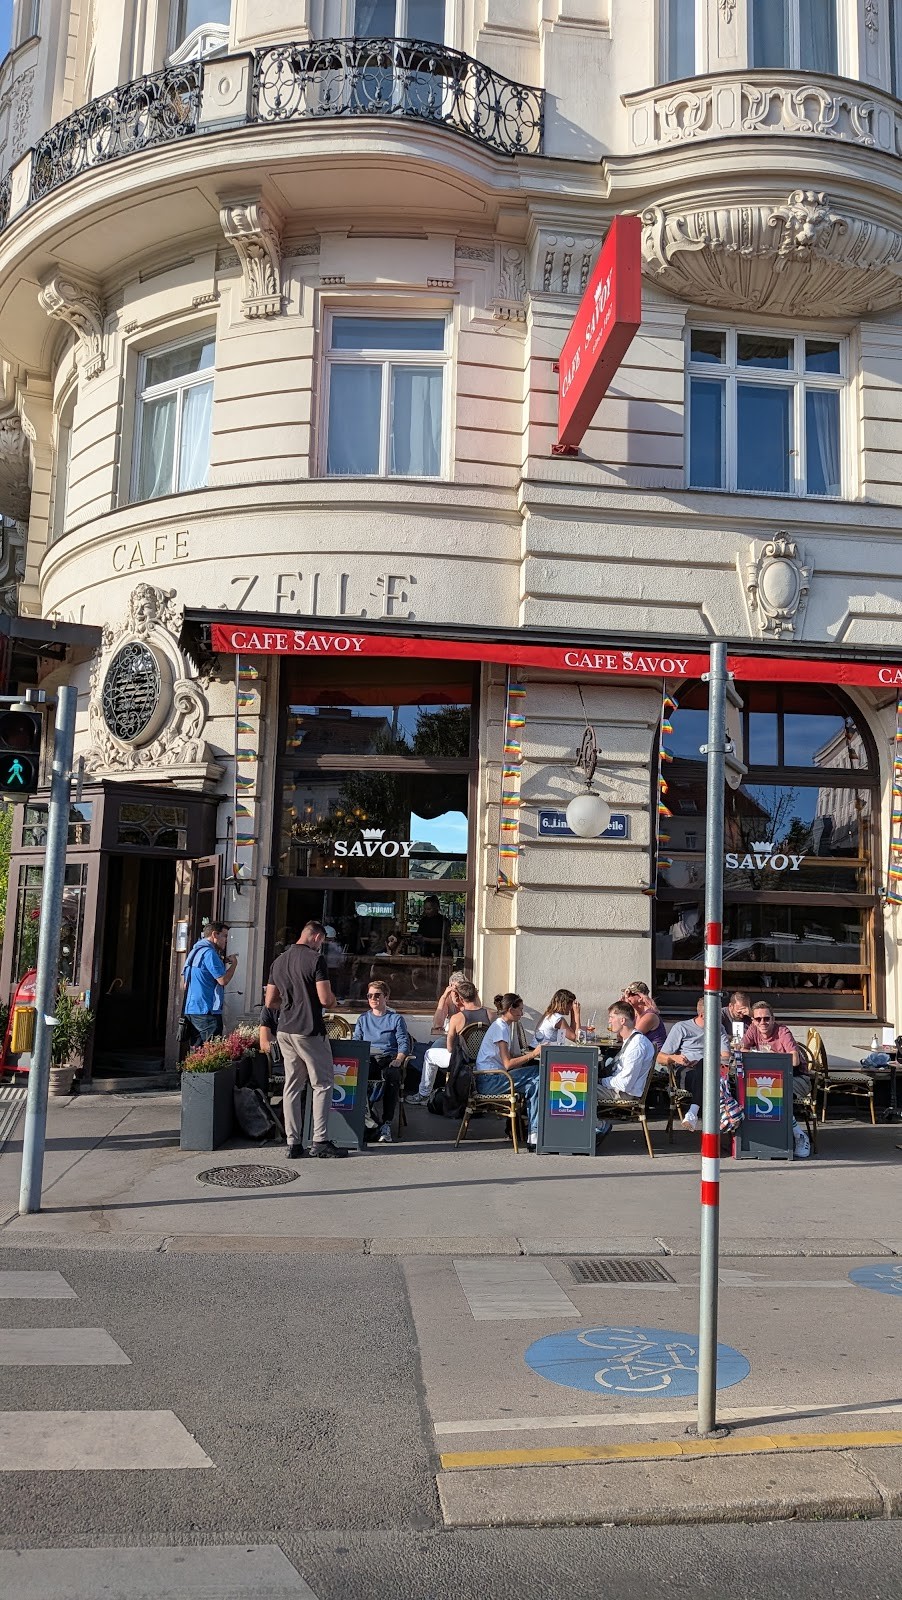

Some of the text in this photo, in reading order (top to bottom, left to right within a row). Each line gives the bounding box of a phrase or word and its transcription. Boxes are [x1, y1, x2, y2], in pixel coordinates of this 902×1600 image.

[562, 267, 613, 398] CAFE SAVOY
[112, 530, 189, 572] CAFE
[230, 572, 417, 619] ZEILE
[231, 631, 366, 652] CAFE SAVOY
[564, 652, 690, 674] CAFE SAVOY
[334, 840, 415, 858] SAVOY
[725, 853, 806, 871] SAVOY
[558, 1081, 577, 1109] S
[756, 1086, 774, 1114] S
